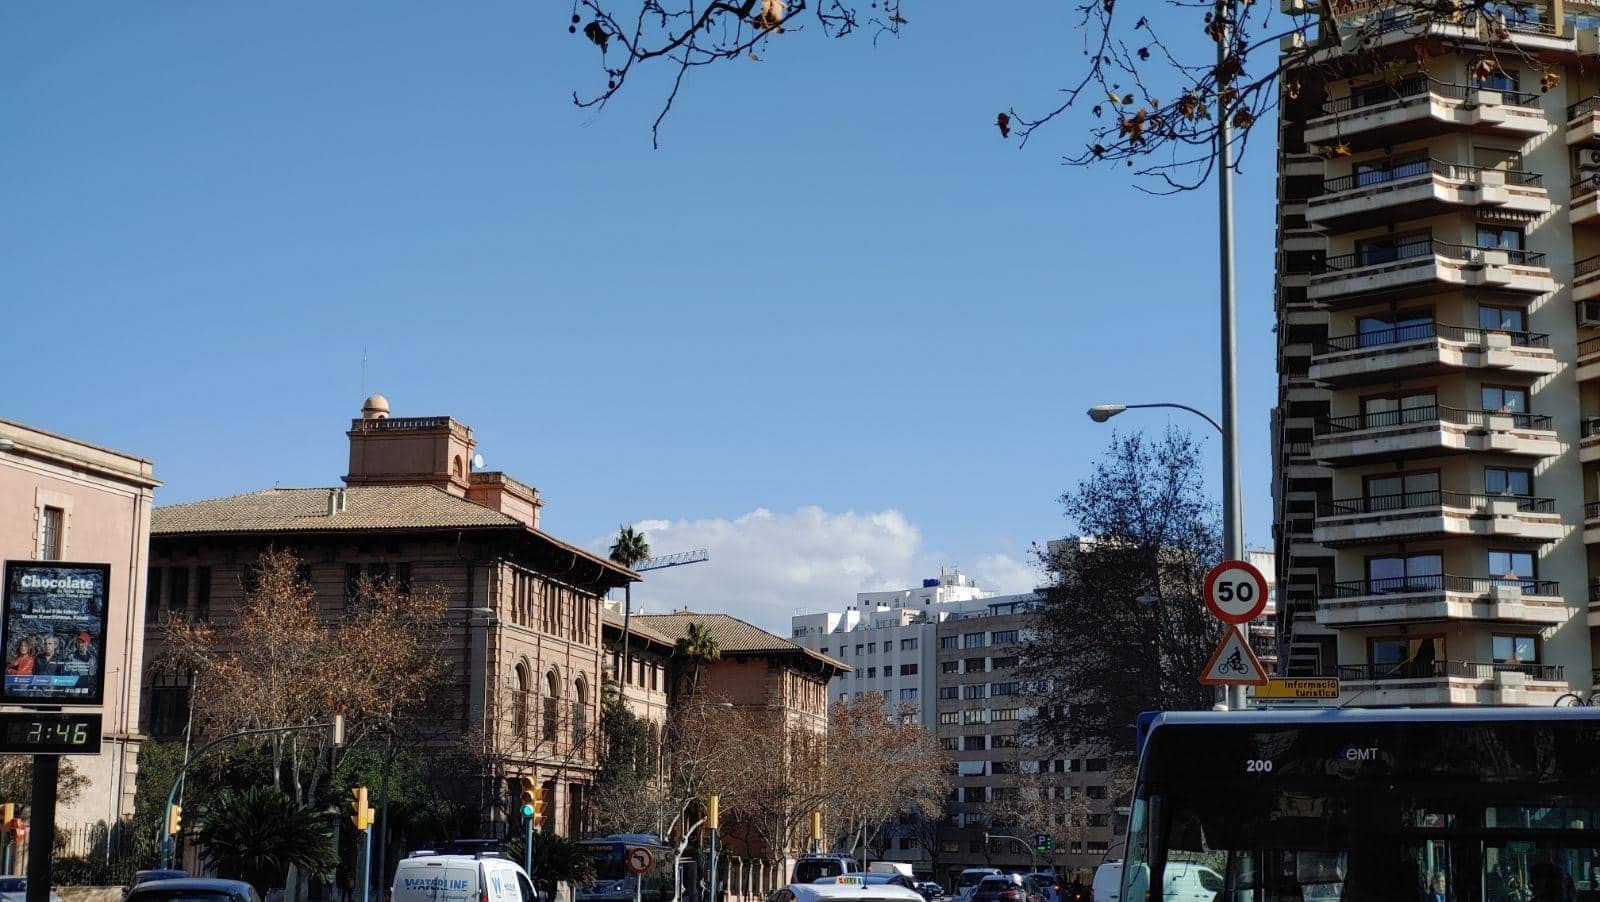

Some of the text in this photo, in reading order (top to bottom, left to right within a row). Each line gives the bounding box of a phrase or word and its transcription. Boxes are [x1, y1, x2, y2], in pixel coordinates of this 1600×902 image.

[21, 574, 94, 589] Chocolate
[1218, 581, 1253, 602] 50
[1246, 759, 1273, 772] 200
